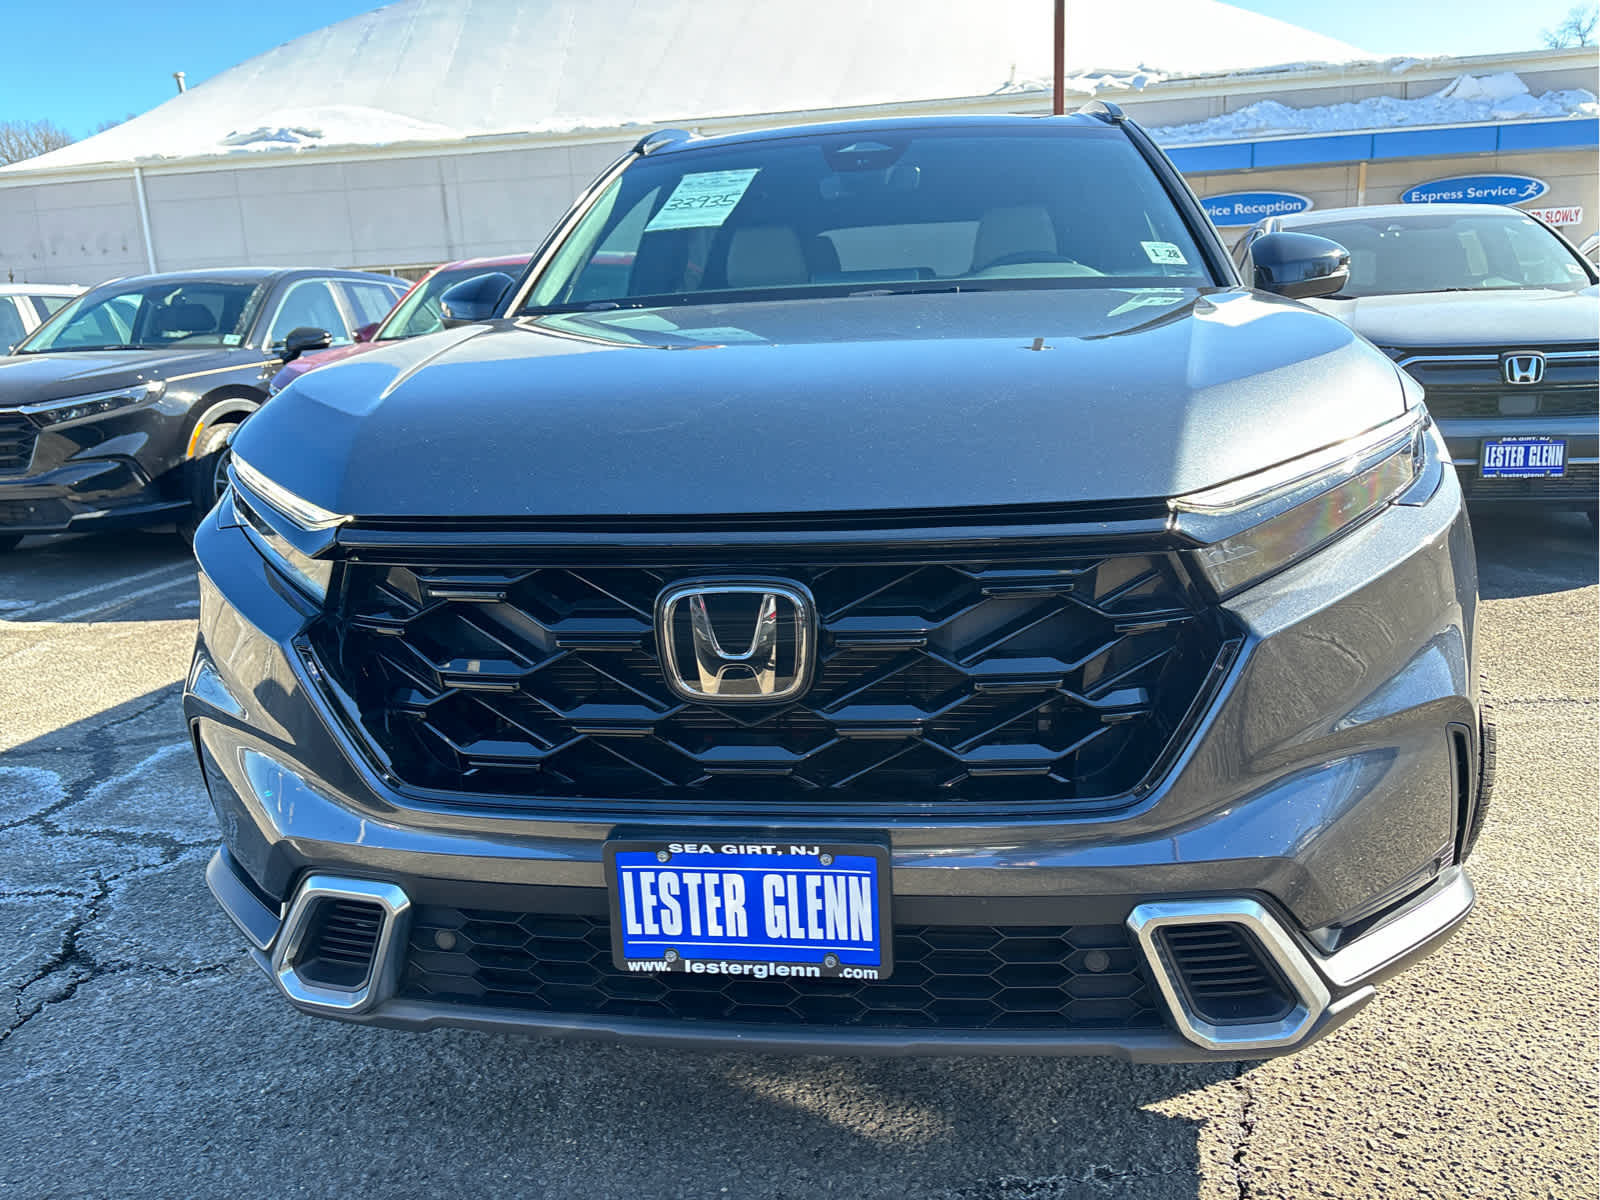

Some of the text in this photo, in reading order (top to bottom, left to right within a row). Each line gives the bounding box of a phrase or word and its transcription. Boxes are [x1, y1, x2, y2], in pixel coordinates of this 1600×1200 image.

[1411, 186, 1517, 204] Express Service
[1204, 200, 1302, 216] vice Reception
[1545, 208, 1580, 223] SLOWLY
[1484, 445, 1564, 468] LESTER GLENN
[668, 843, 820, 857] SEA GIRT, NJ
[622, 871, 874, 942] LESTER GLENN
[627, 959, 879, 980] www. lesterglenn .com
